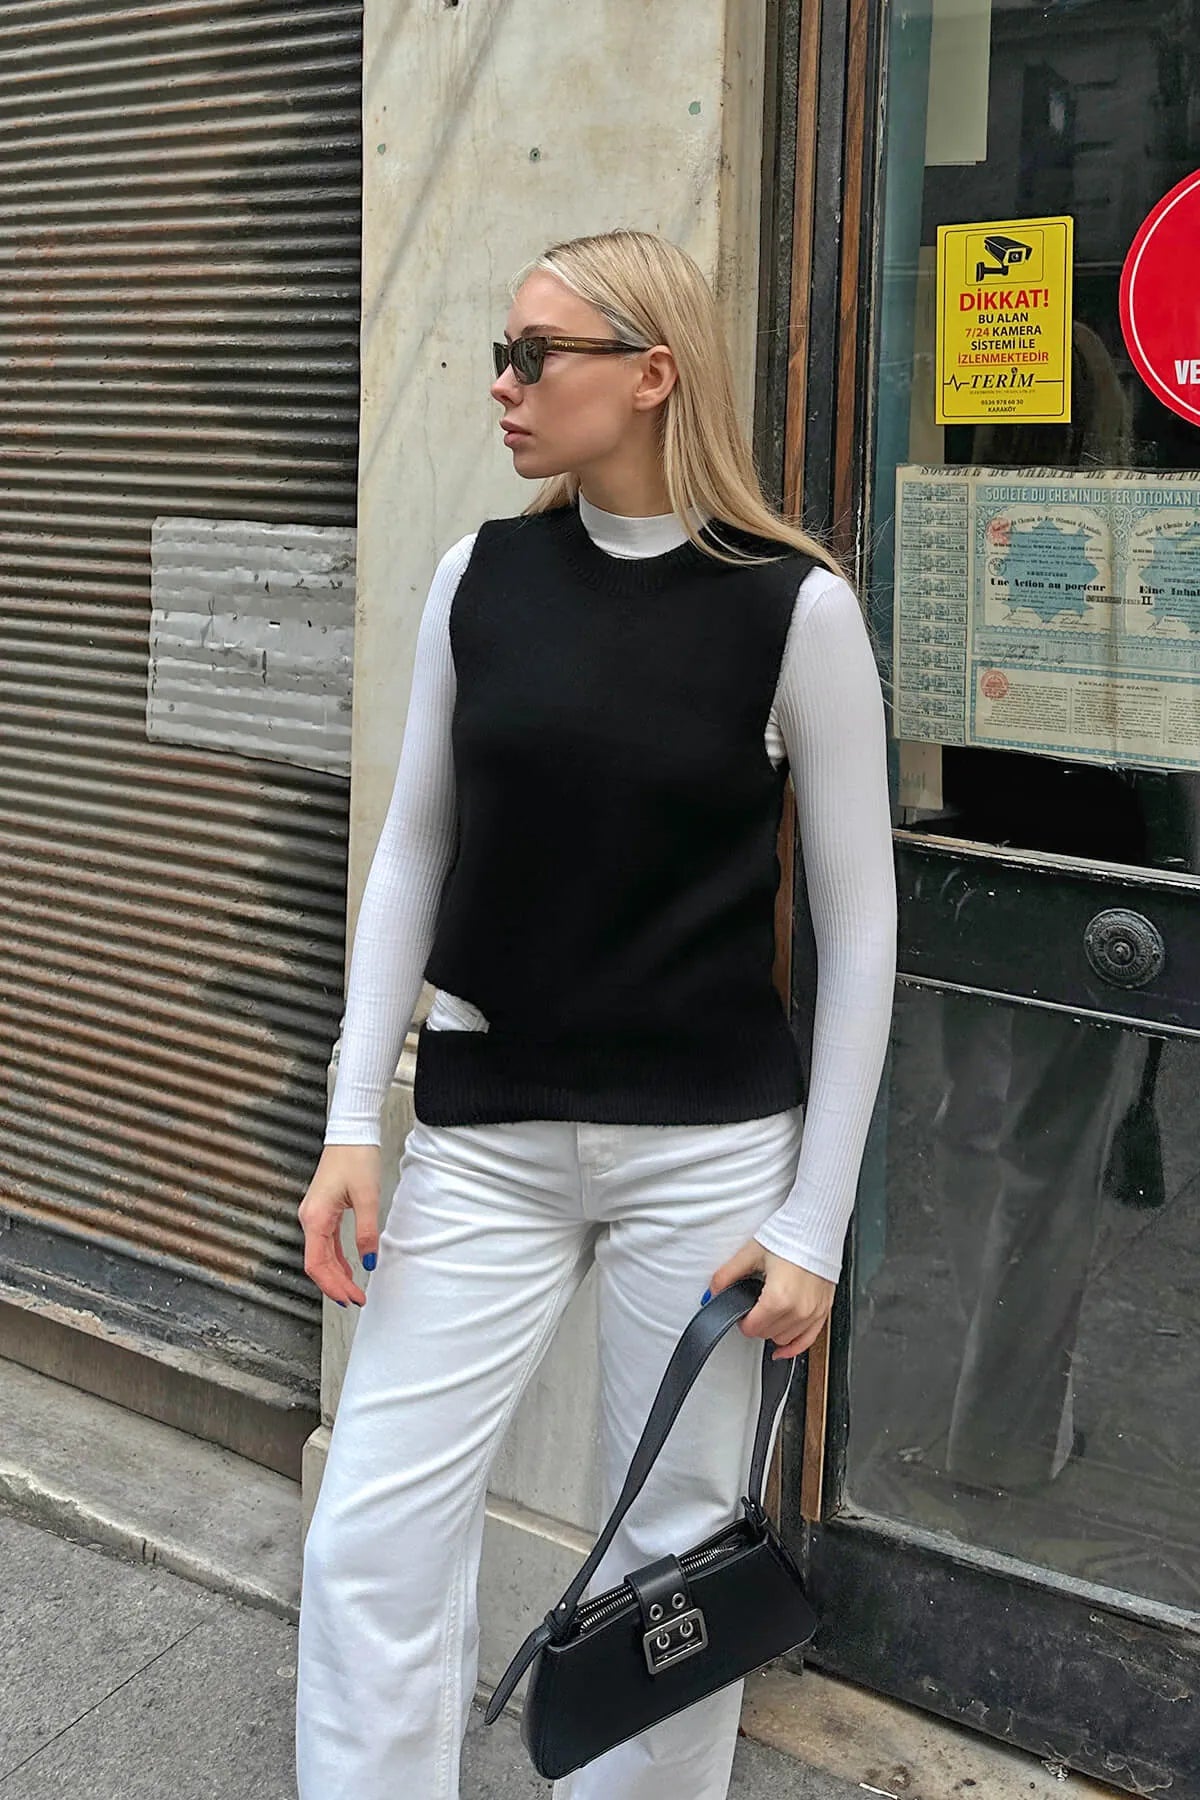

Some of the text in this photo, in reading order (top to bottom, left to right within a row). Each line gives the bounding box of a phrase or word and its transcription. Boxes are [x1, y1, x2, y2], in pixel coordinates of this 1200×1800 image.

[959, 288, 1049, 312] DİKKAT!
[978, 312, 1029, 324] BU ALAN
[965, 325, 1042, 338] 7/24 KAMERA
[971, 337, 1035, 351] SİSTEMİ İLE
[958, 350, 1049, 365] İZLENMEKTEDİR
[1031, 488, 1046, 502] DU
[1048, 489, 1091, 504] CHEMIN
[1109, 490, 1131, 505] FER
[1134, 491, 1193, 506] OTTOMAN
[1014, 578, 1045, 589] Action
[1048, 581, 1061, 590] au
[1065, 581, 1107, 593] porteur
[1139, 585, 1166, 595] Eine
